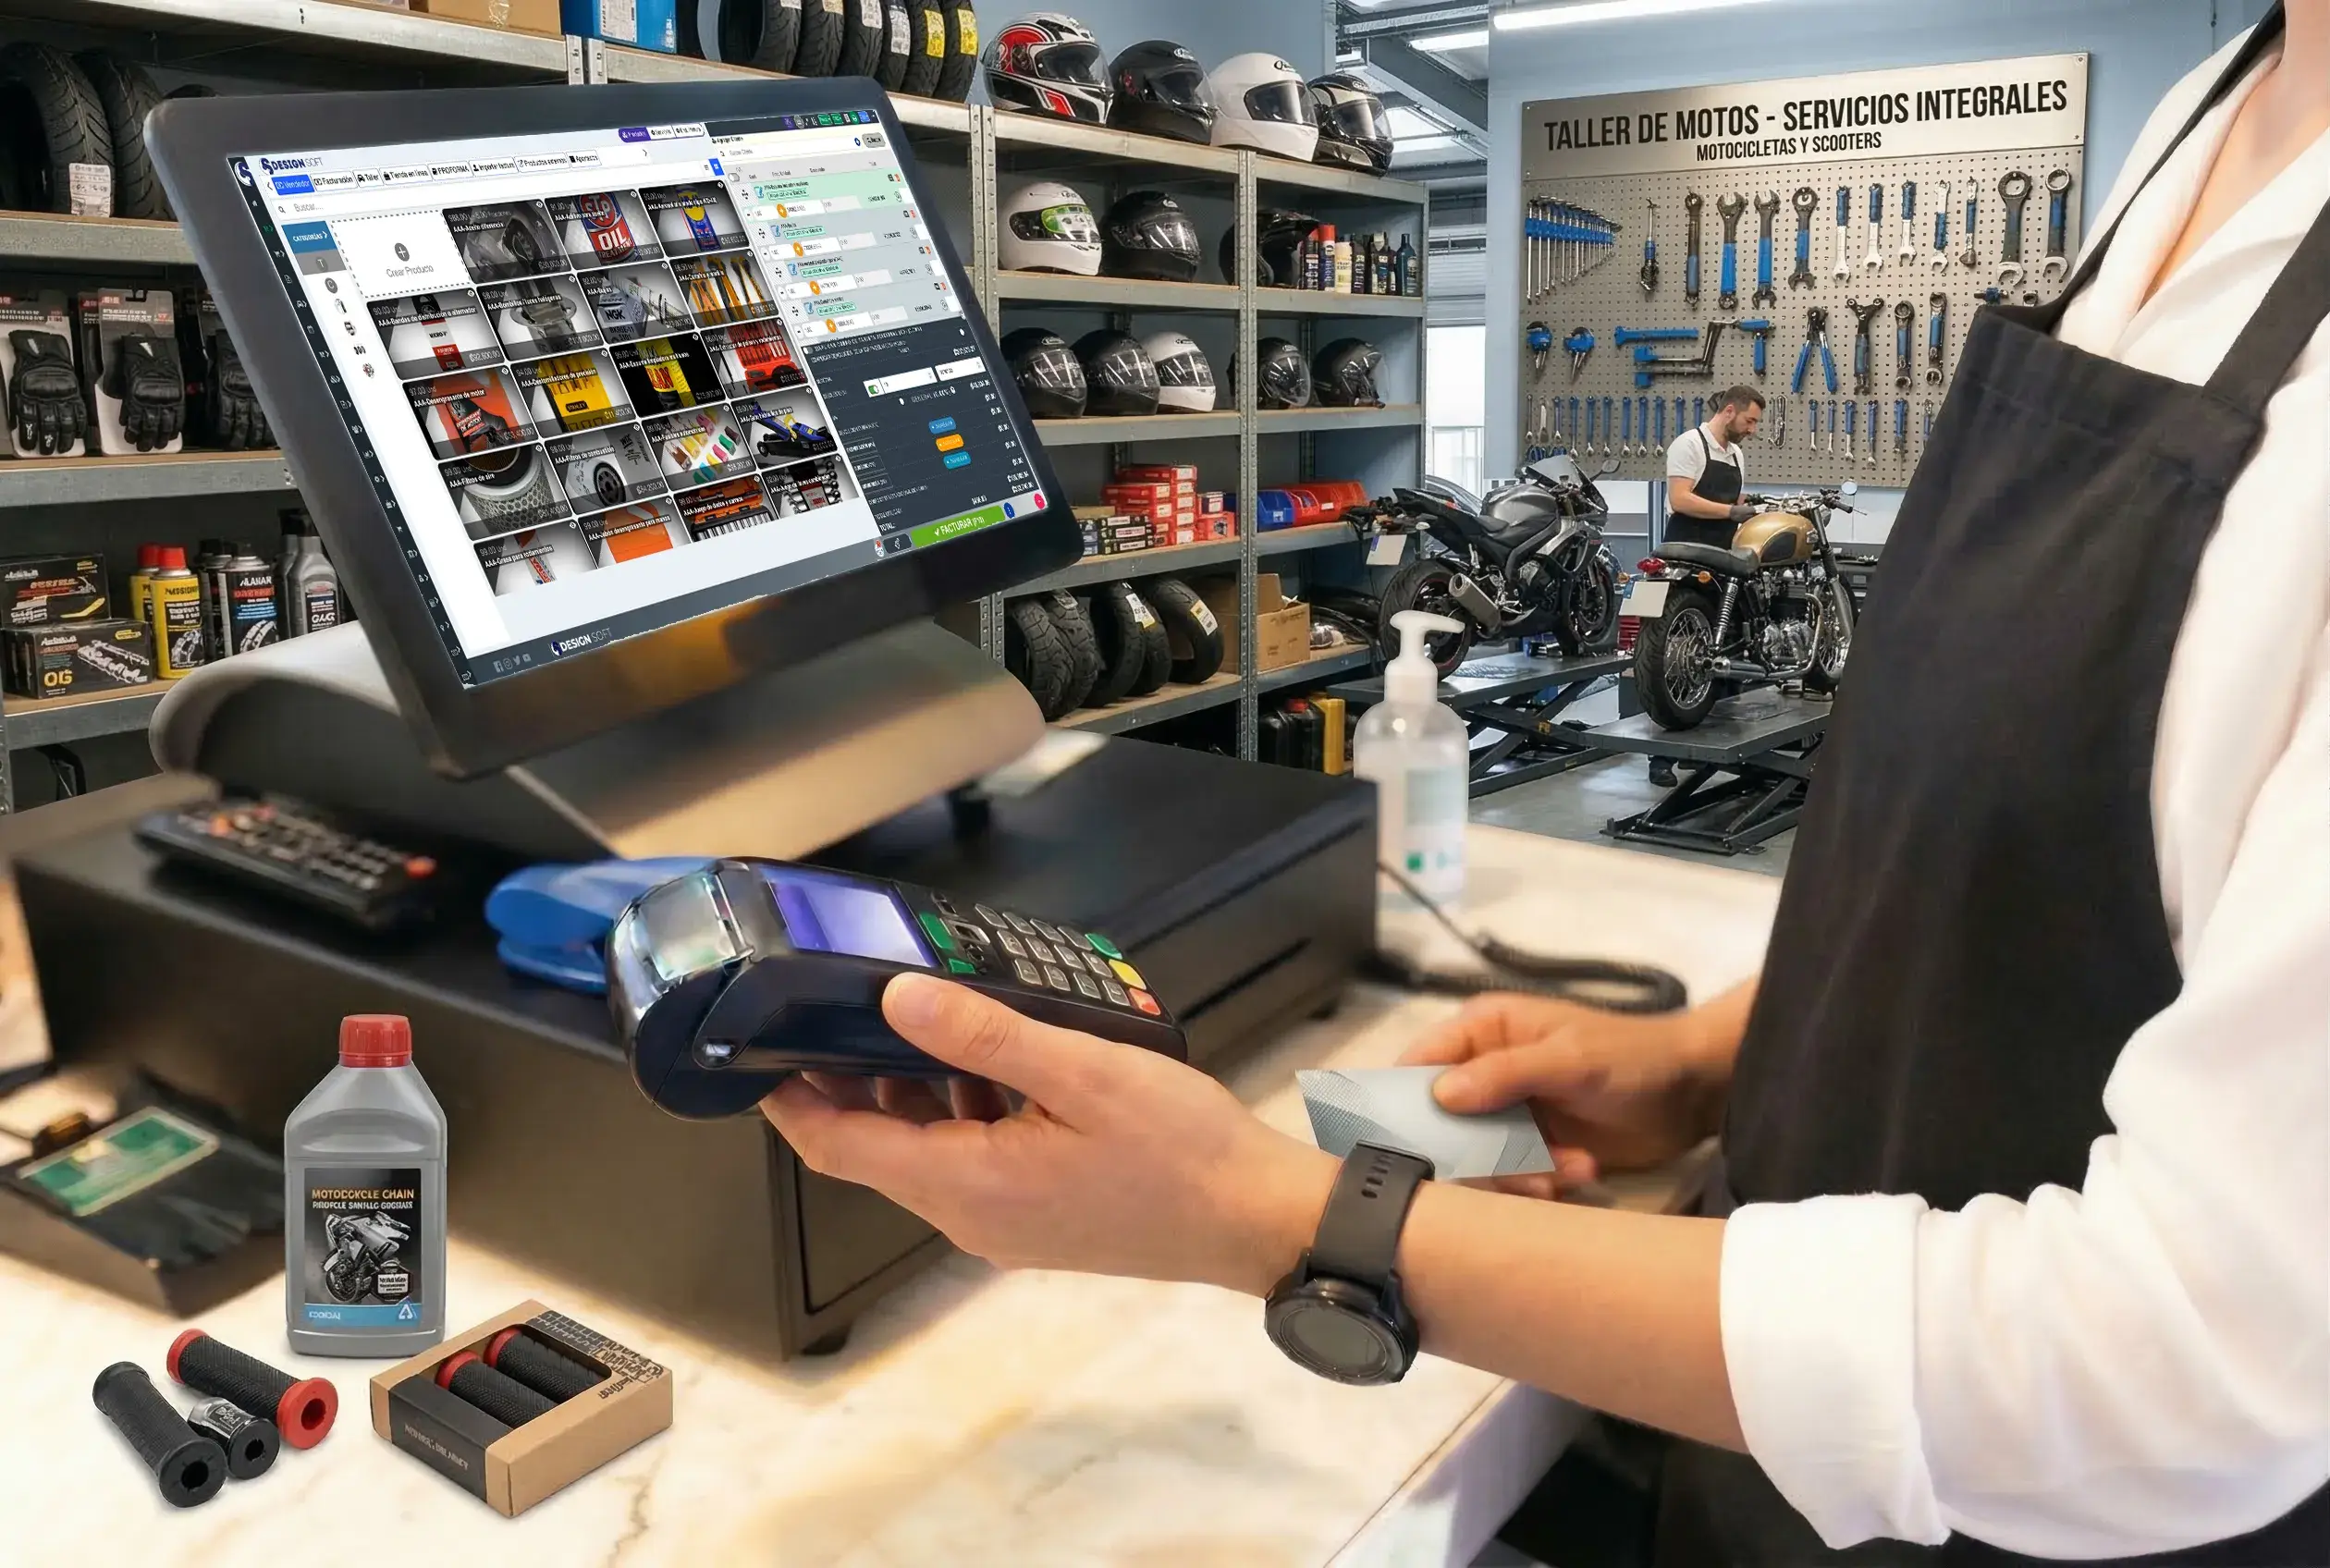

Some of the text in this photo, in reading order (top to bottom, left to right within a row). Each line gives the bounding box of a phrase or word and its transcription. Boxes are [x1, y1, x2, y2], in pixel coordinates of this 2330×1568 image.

[1544, 116, 1631, 152] TALLER
[1638, 113, 1668, 144] DE
[1675, 104, 1759, 141] MOTOS
[1784, 92, 1909, 131] SERVICIOS
[1916, 80, 2067, 122] INTEGRALES
[1696, 131, 1882, 163] MOTOCICLETAS Y SCOOTERS
[270, 156, 325, 170] DESIGN SOFT
[436, 165, 470, 175] PROFORMA
[321, 175, 354, 186] Facturación
[363, 172, 381, 182] Taller
[389, 170, 408, 179] Tienda
[283, 178, 311, 190] Vendedor
[291, 231, 324, 242] CATEGORÍAS
[599, 228, 626, 251] OIL
[598, 239, 631, 260] TREATMENT
[385, 263, 435, 278] Crear Producto
[377, 315, 411, 327] AAA-Bandas
[604, 307, 625, 322] NGK
[413, 392, 463, 409] AAA-Desengrasante
[468, 388, 486, 398] motor
[554, 452, 582, 465] AAA-Filtros
[448, 475, 479, 489] AAA-Filtros
[939, 517, 973, 535] FACTURAR
[484, 544, 553, 570] AAA-Grasa para rodamientos
[558, 626, 613, 653] DESIGN SOFT
[382, 1189, 414, 1199] CHAIN
